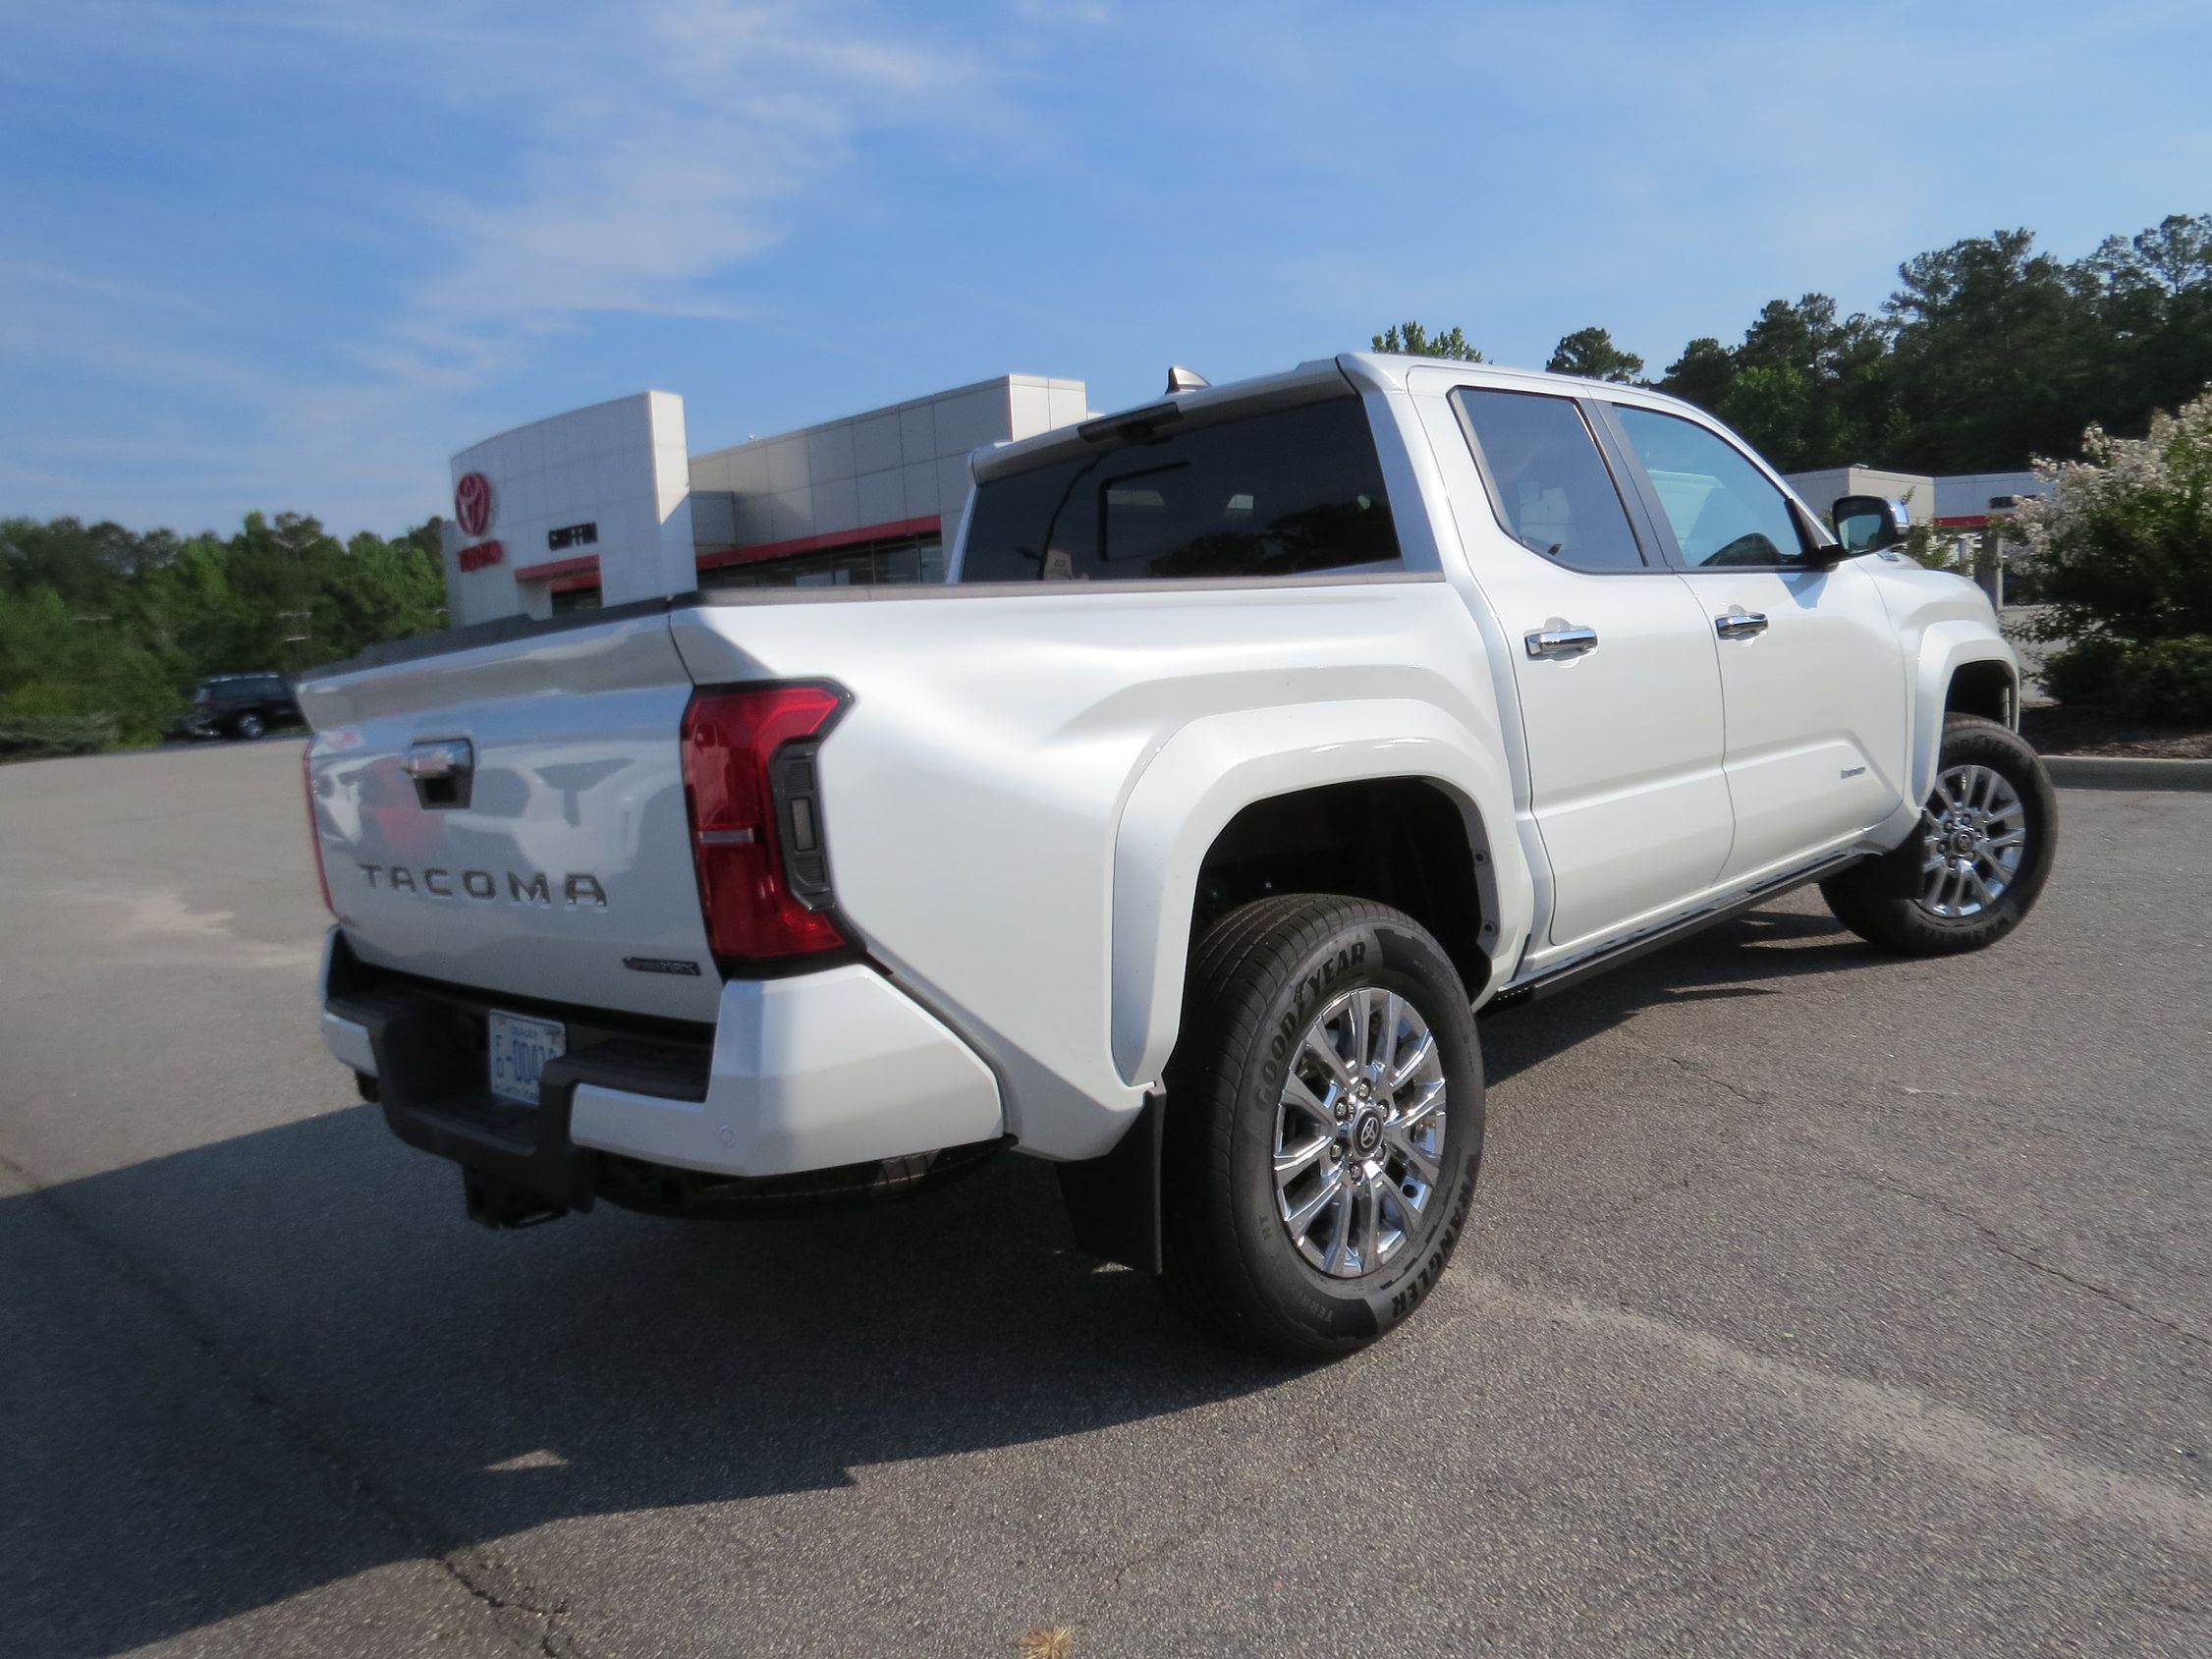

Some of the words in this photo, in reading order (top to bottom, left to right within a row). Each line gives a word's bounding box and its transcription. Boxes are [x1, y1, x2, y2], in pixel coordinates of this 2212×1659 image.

[359, 863, 608, 907] TACOMA
[1256, 940, 1366, 1111] GOODYEAR
[1392, 1155, 1482, 1318] WRANGLER
